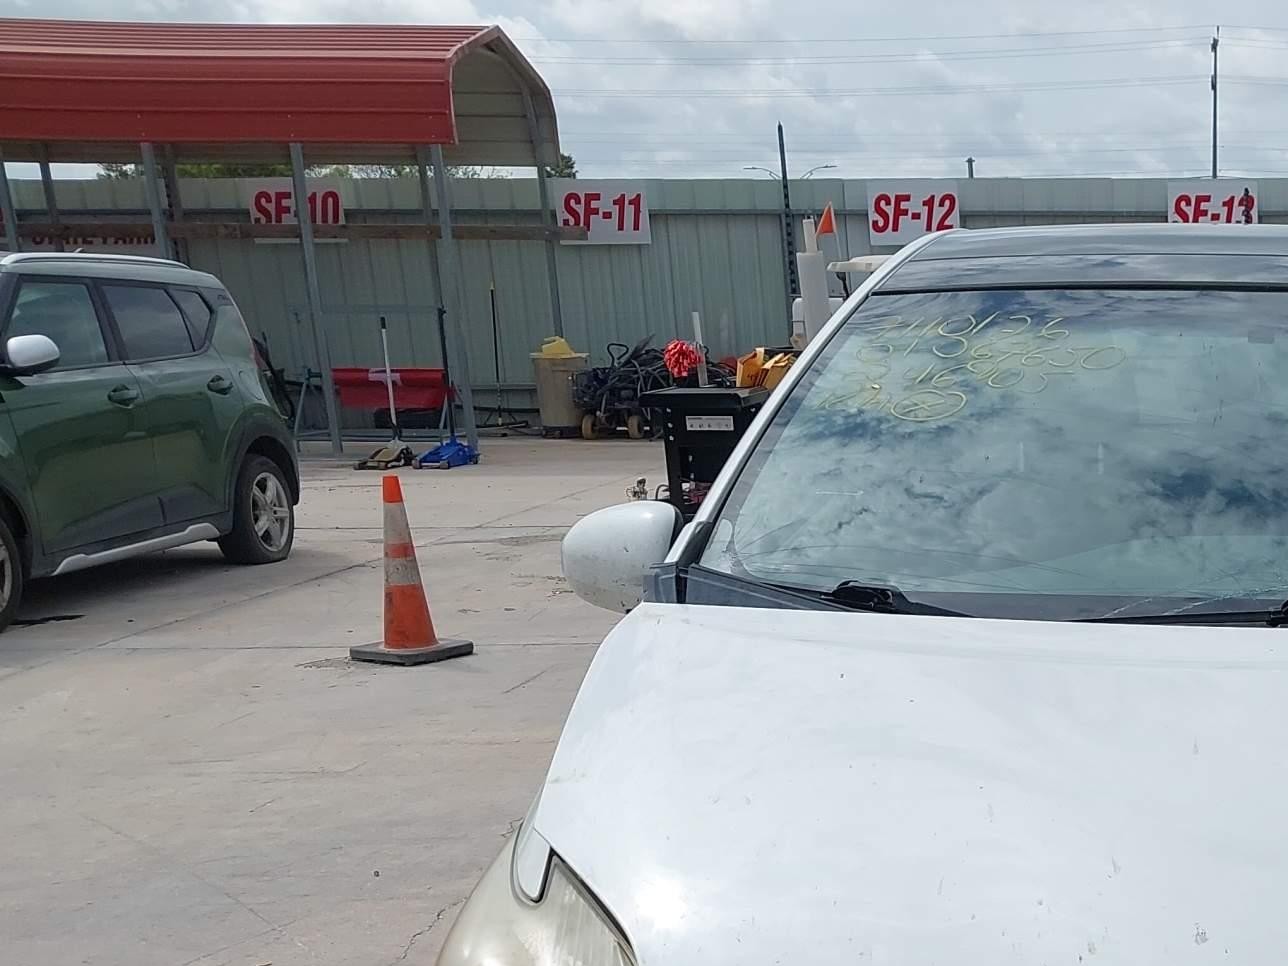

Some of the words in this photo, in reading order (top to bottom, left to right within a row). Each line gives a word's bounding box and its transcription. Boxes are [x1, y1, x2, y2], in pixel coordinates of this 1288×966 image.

[561, 192, 642, 231] SF-11
[871, 193, 956, 233] SF-12
[1174, 194, 1256, 223] SF-13
